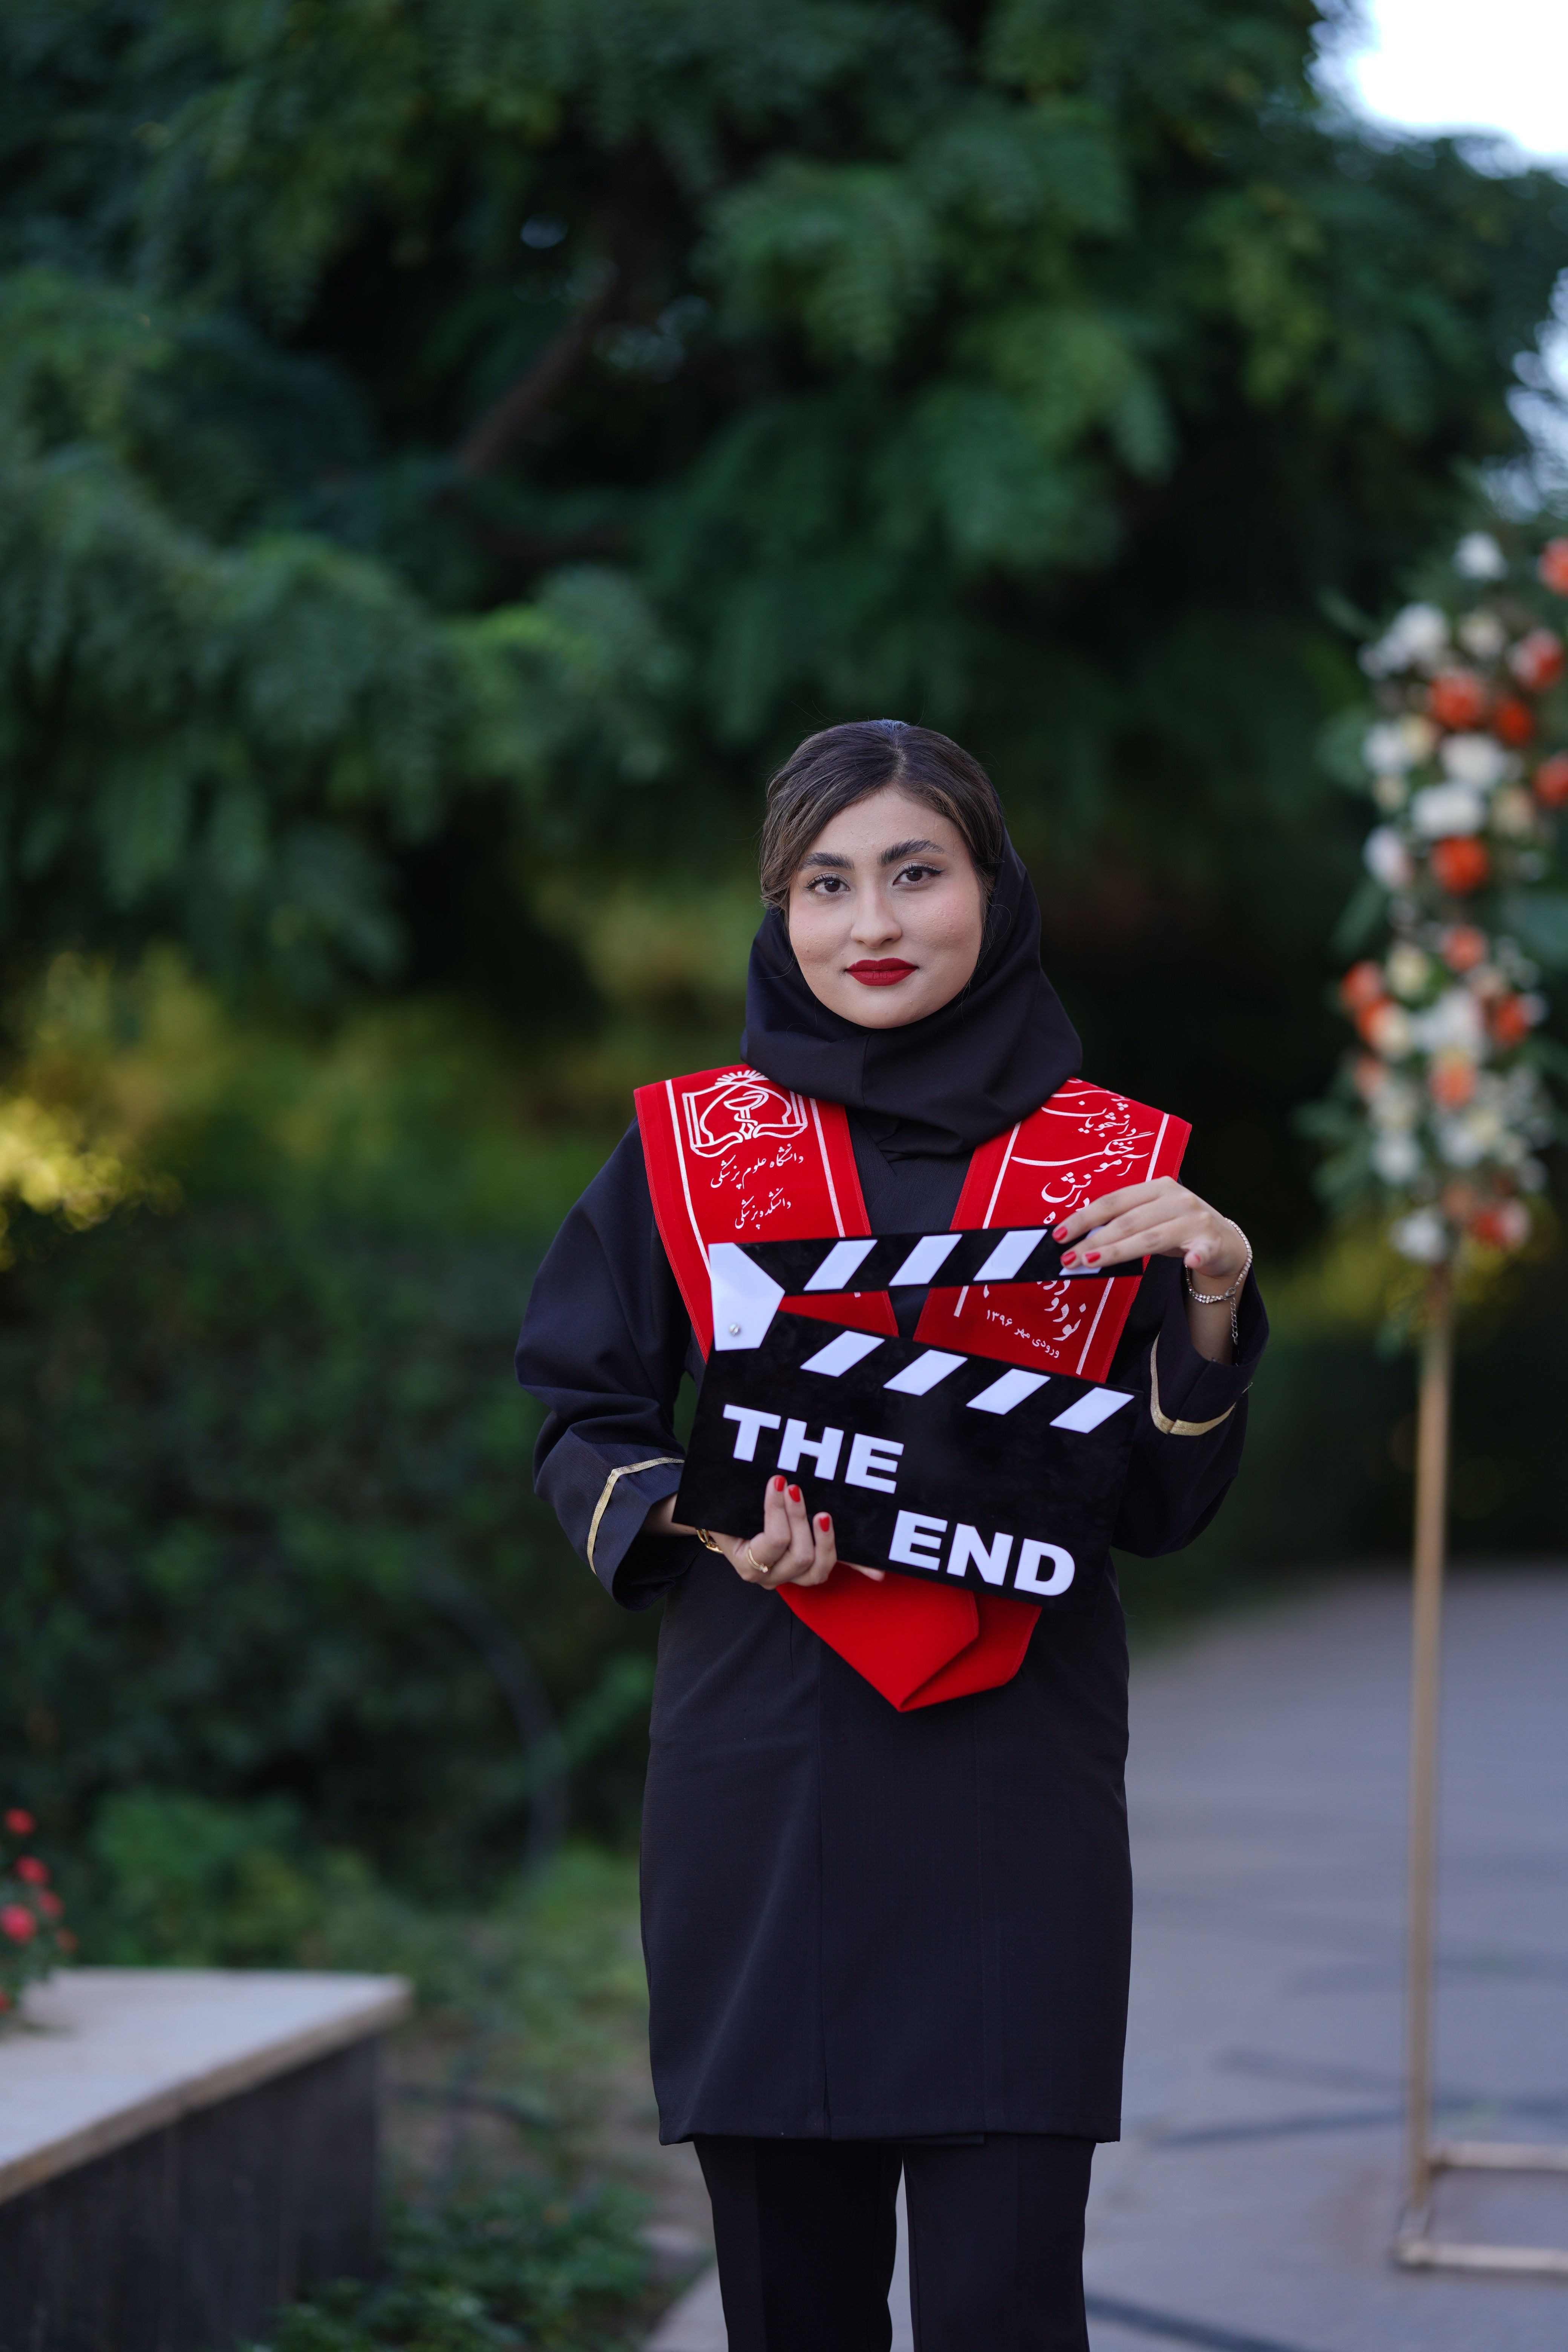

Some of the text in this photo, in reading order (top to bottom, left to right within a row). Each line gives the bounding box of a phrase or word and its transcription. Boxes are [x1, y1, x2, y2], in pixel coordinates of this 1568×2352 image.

[710, 1143, 804, 1190] دانشگاه علوم پزشکی
[735, 1188, 791, 1230] دانشکده پزشکی
[987, 1309, 1059, 1358] ورودی مهر ۱۳۹۶
[722, 1404, 904, 1494] THE
[888, 1510, 1075, 1596] END
